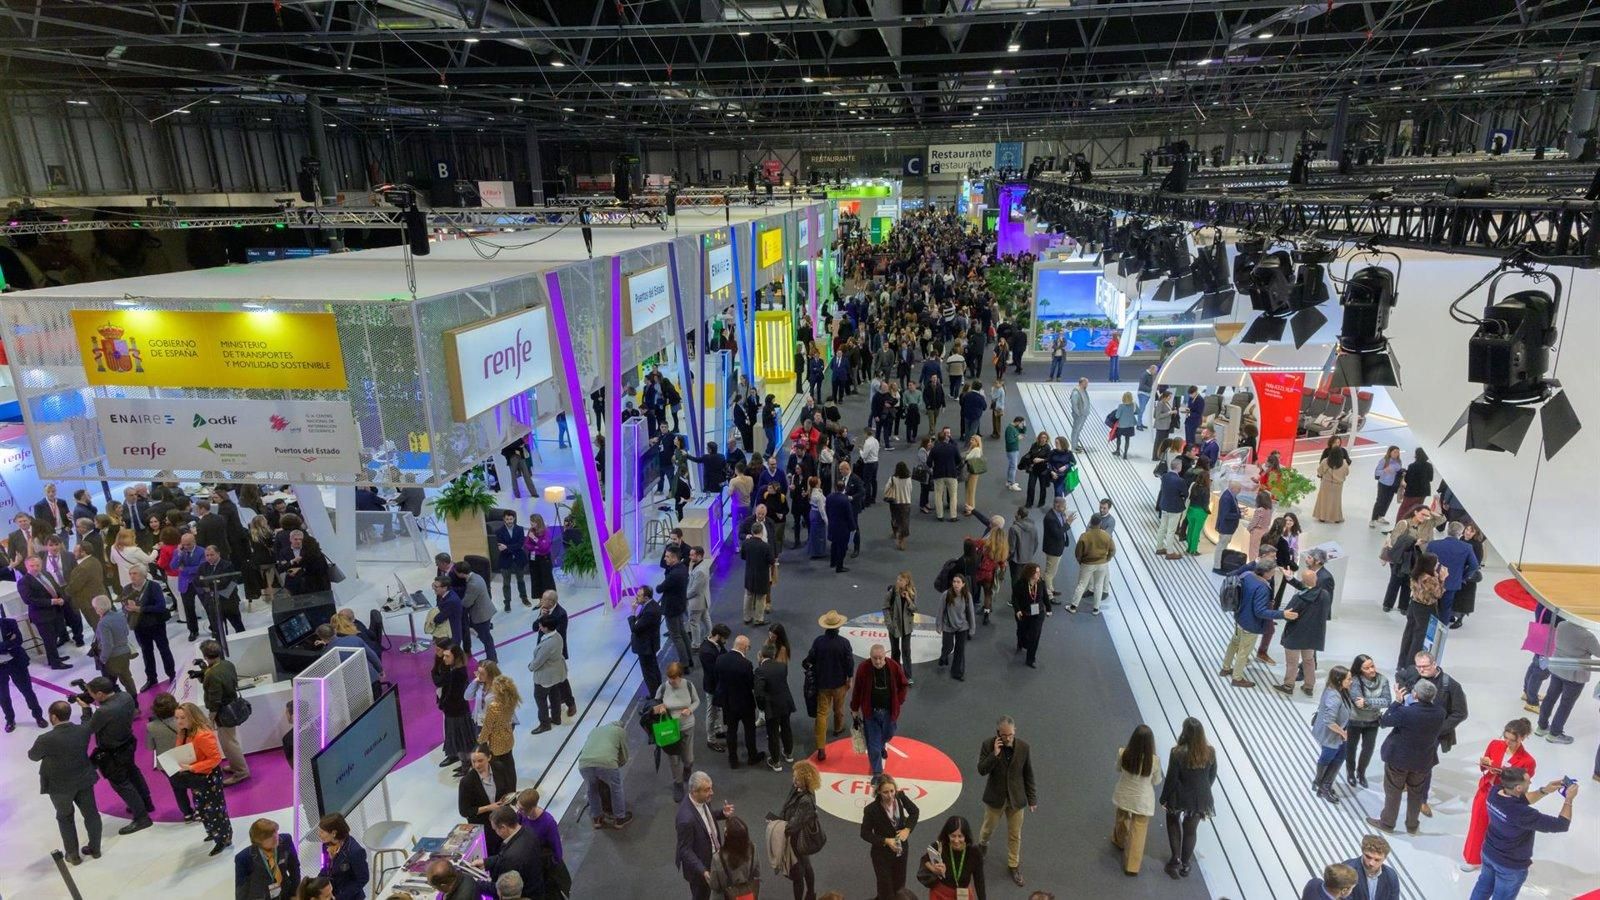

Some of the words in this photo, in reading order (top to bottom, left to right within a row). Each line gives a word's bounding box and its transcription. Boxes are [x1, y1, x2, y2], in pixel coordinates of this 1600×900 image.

[811, 155, 856, 163] RESTAURANTE
[931, 149, 992, 159] Restaurante
[437, 163, 449, 178] B
[907, 158, 919, 173] C
[931, 165, 939, 173] C
[634, 291, 649, 303] Puertos
[654, 285, 665, 296] Estado
[148, 340, 196, 348] GOBIERNO
[220, 341, 267, 349] MINISTERIO
[165, 348, 198, 358] ESPAÑA
[235, 351, 293, 359] TRANSPORTES
[483, 328, 532, 380] renfe
[232, 361, 278, 369] MOVILIDAD
[281, 361, 331, 370] SOSTENIBLE
[208, 415, 237, 425] adif
[3, 448, 31, 464] renfe
[123, 442, 166, 460] renfe
[315, 447, 340, 455] Estado
[860, 630, 887, 638] Fitu
